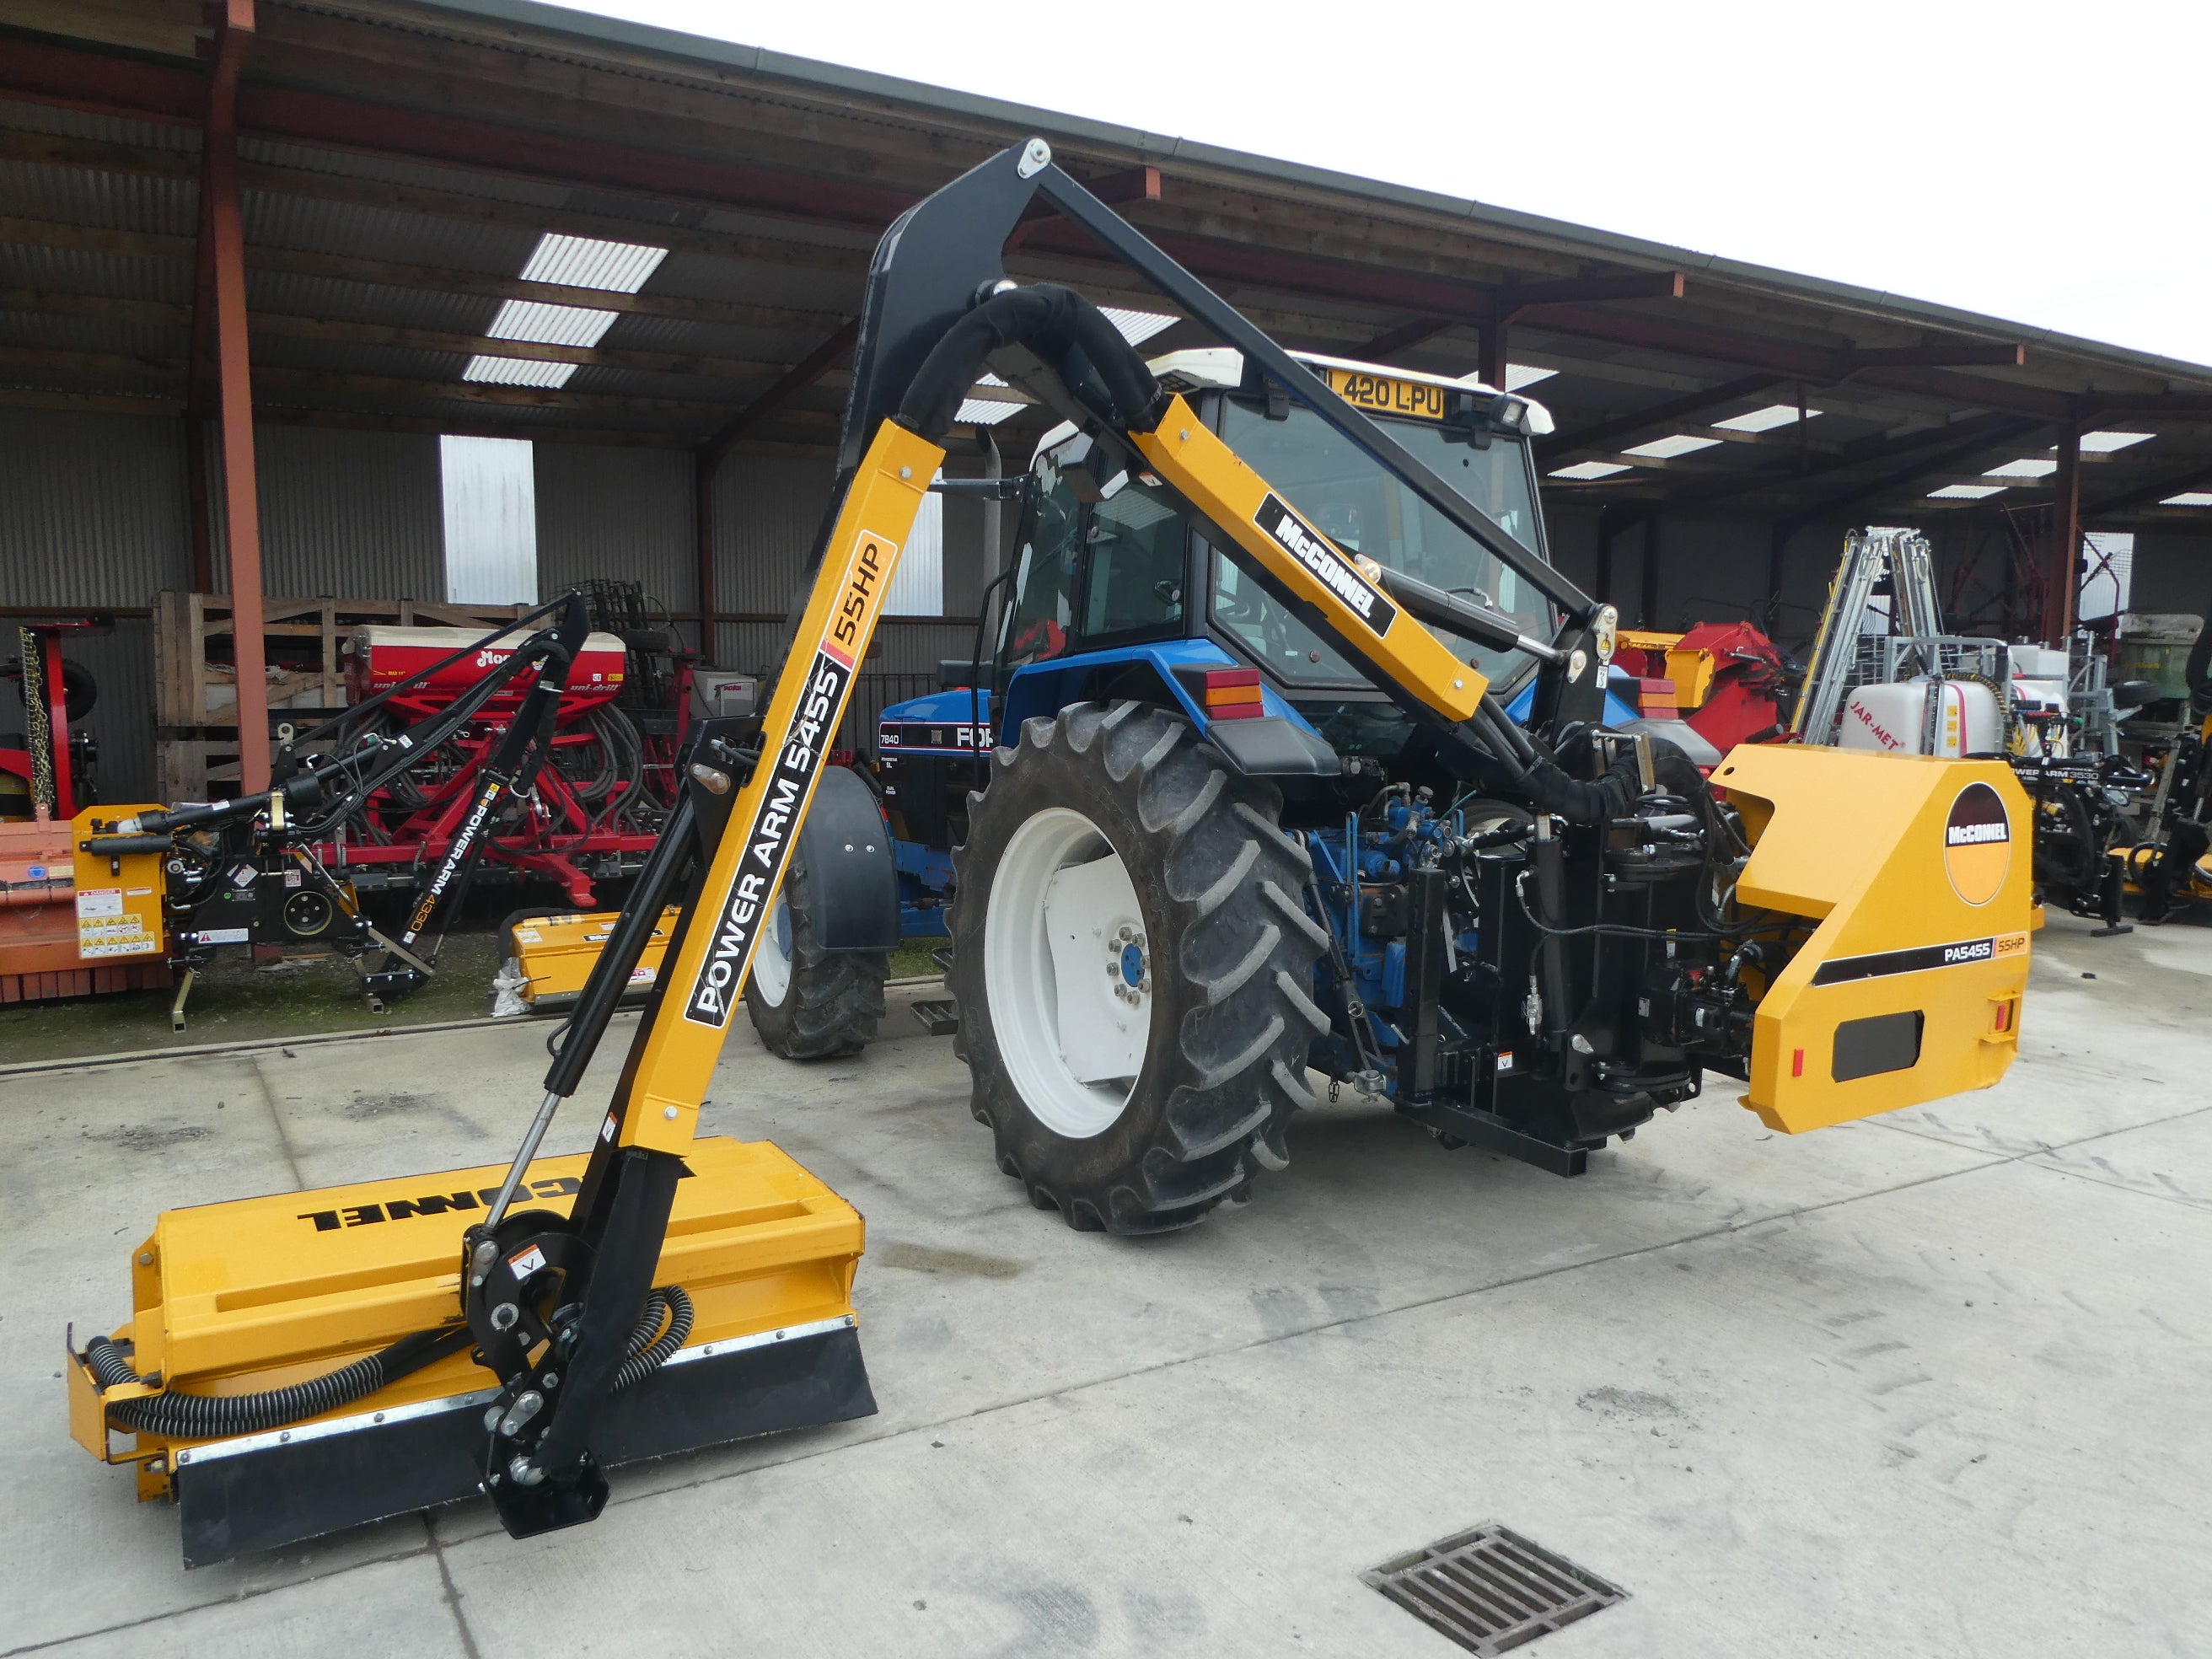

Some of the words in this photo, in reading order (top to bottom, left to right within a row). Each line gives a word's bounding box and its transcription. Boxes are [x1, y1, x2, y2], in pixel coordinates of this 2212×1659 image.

[1395, 383, 1442, 416] LPU
[1274, 513, 1375, 619] McCONNEL
[880, 734, 899, 744] 7840
[1850, 701, 1899, 751] JAR-MET
[696, 872, 765, 1013] POWER
[753, 777, 799, 869] ARM
[784, 670, 839, 772] 5455
[834, 542, 879, 647] 55HP
[2070, 771, 2099, 780] 3530
[449, 805, 488, 860] POWER
[431, 859, 456, 895] ARM
[411, 894, 436, 932] 4330
[1944, 942, 1990, 962] PA5455
[1997, 937, 2025, 953] 55HP
